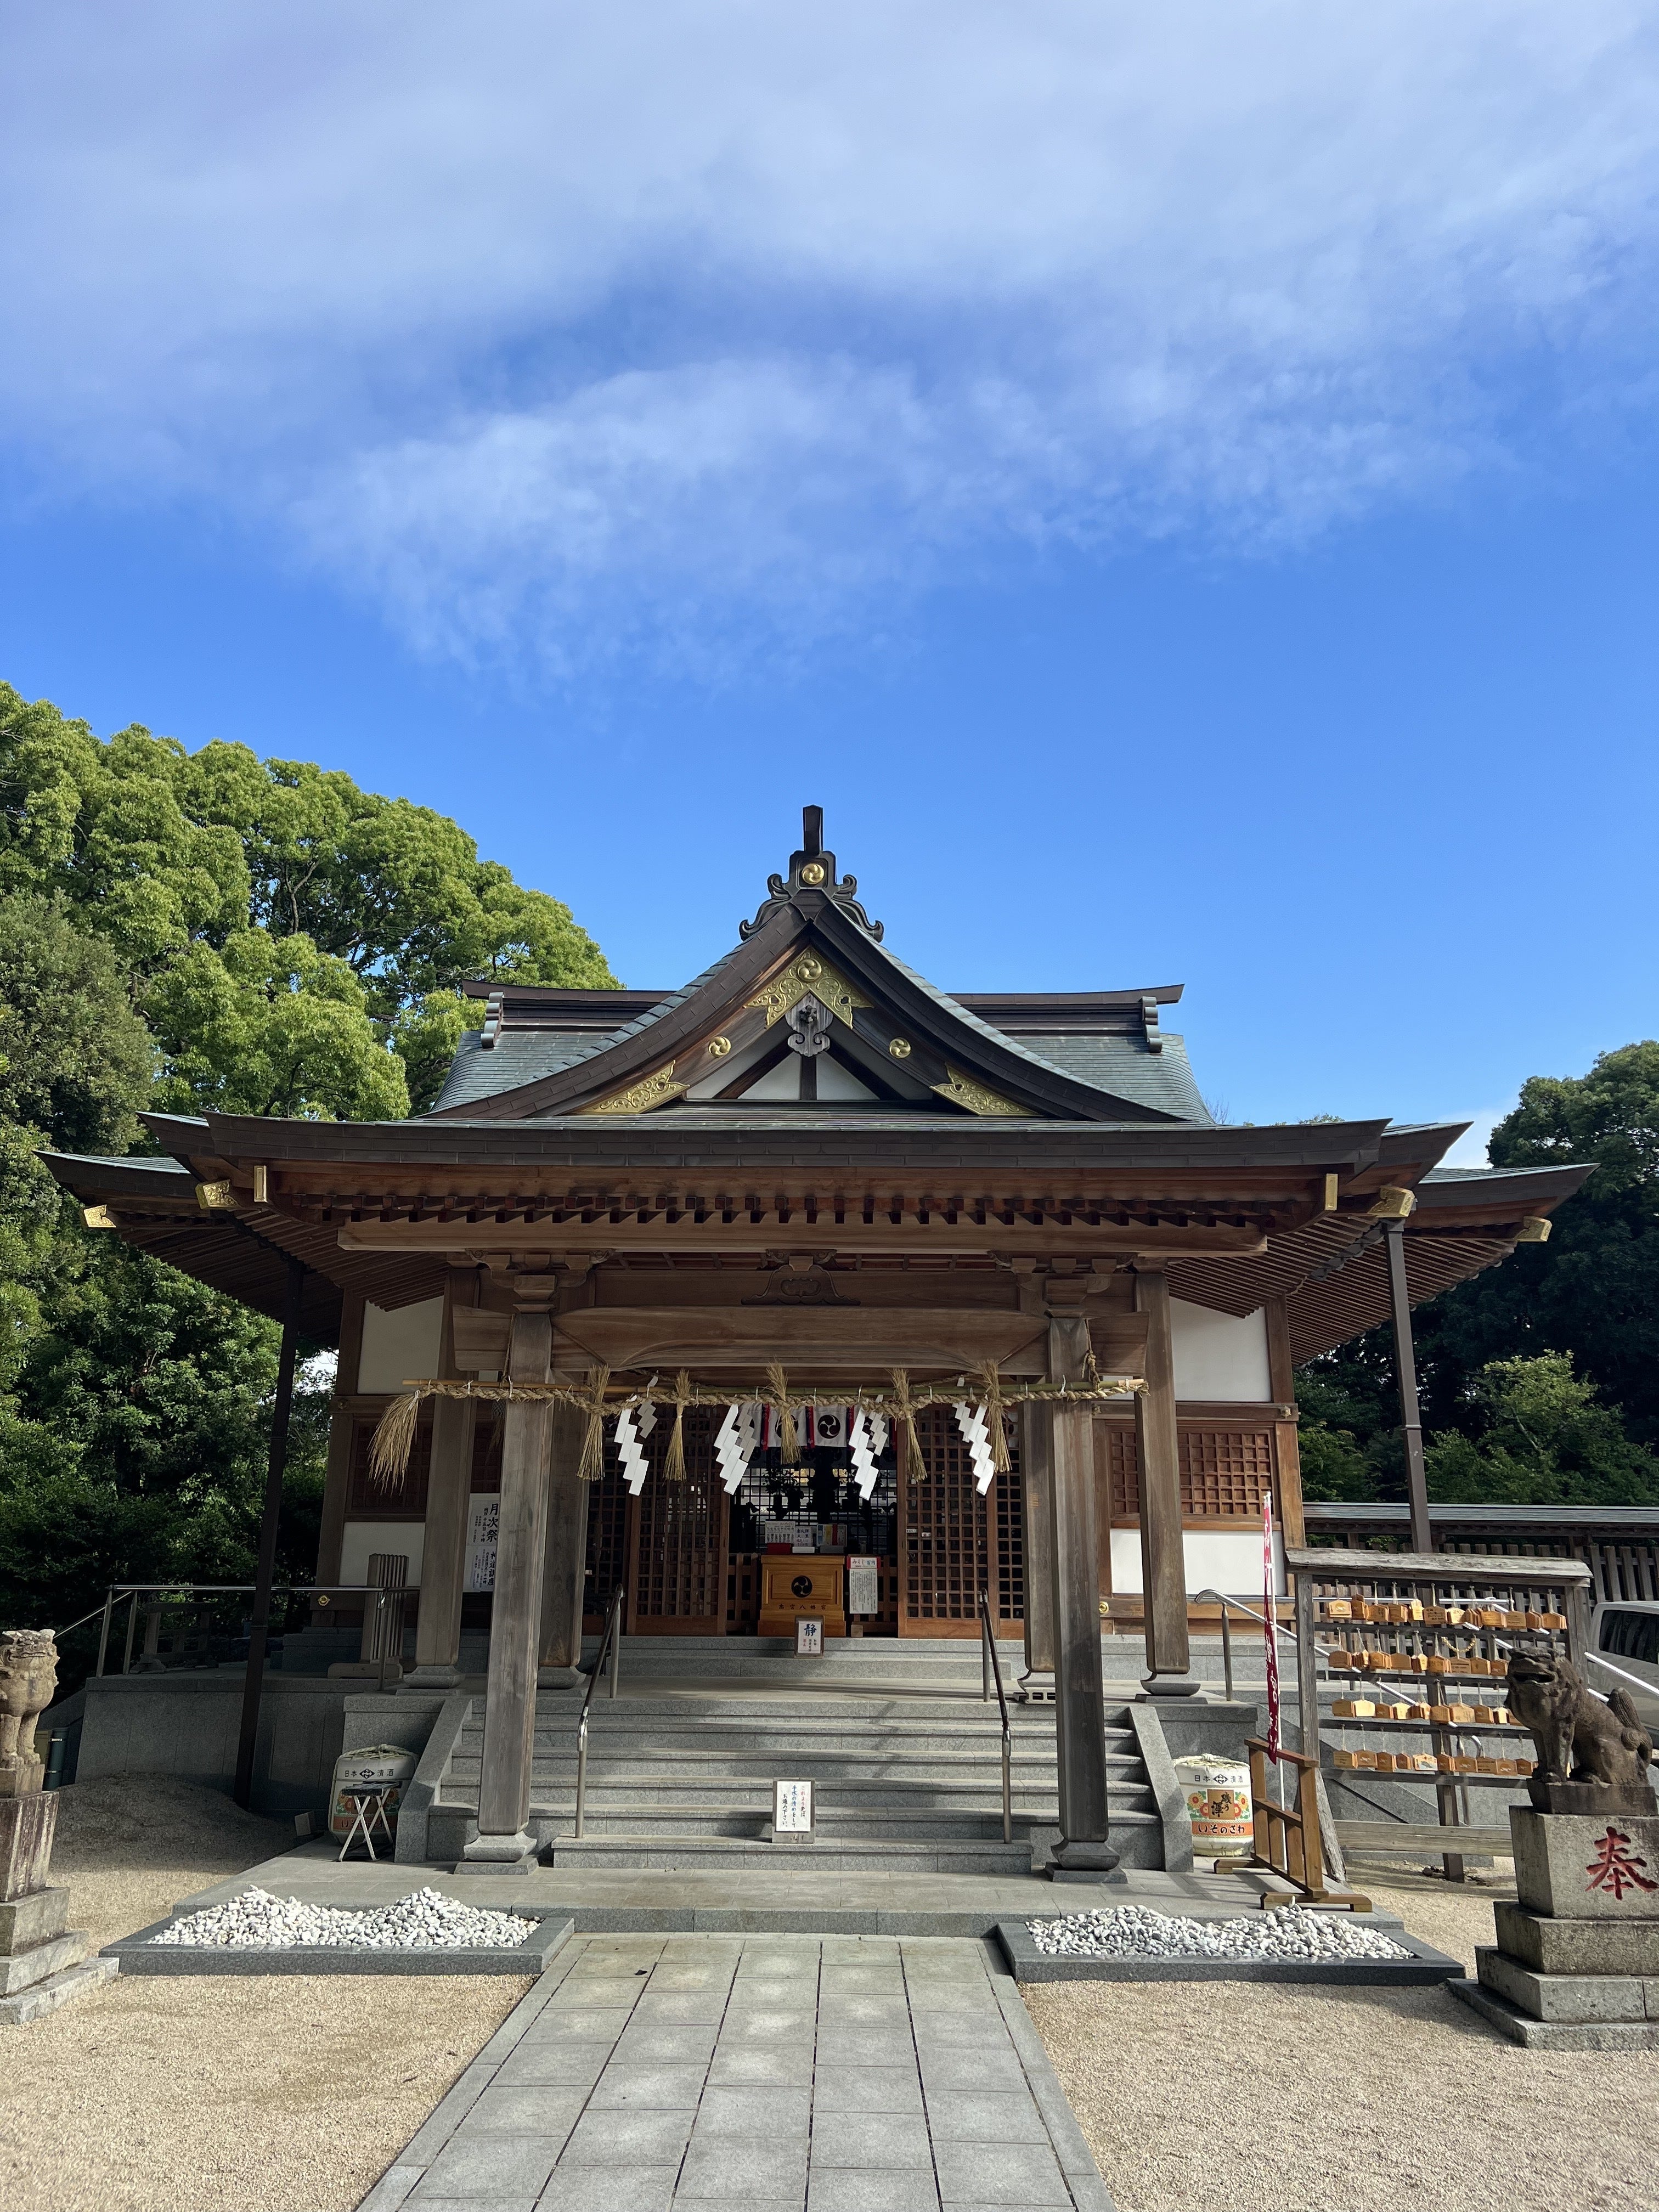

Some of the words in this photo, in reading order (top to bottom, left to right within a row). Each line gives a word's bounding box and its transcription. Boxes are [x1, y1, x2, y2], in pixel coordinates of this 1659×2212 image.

[486, 1503, 499, 1542] 月次祭
[804, 1624, 817, 1637] 静
[377, 1769, 394, 1777] 清酒
[1230, 1775, 1243, 1784] 清酒
[1198, 1824, 1245, 1835] いそのさわ
[1585, 1826, 1659, 1900] 奉
